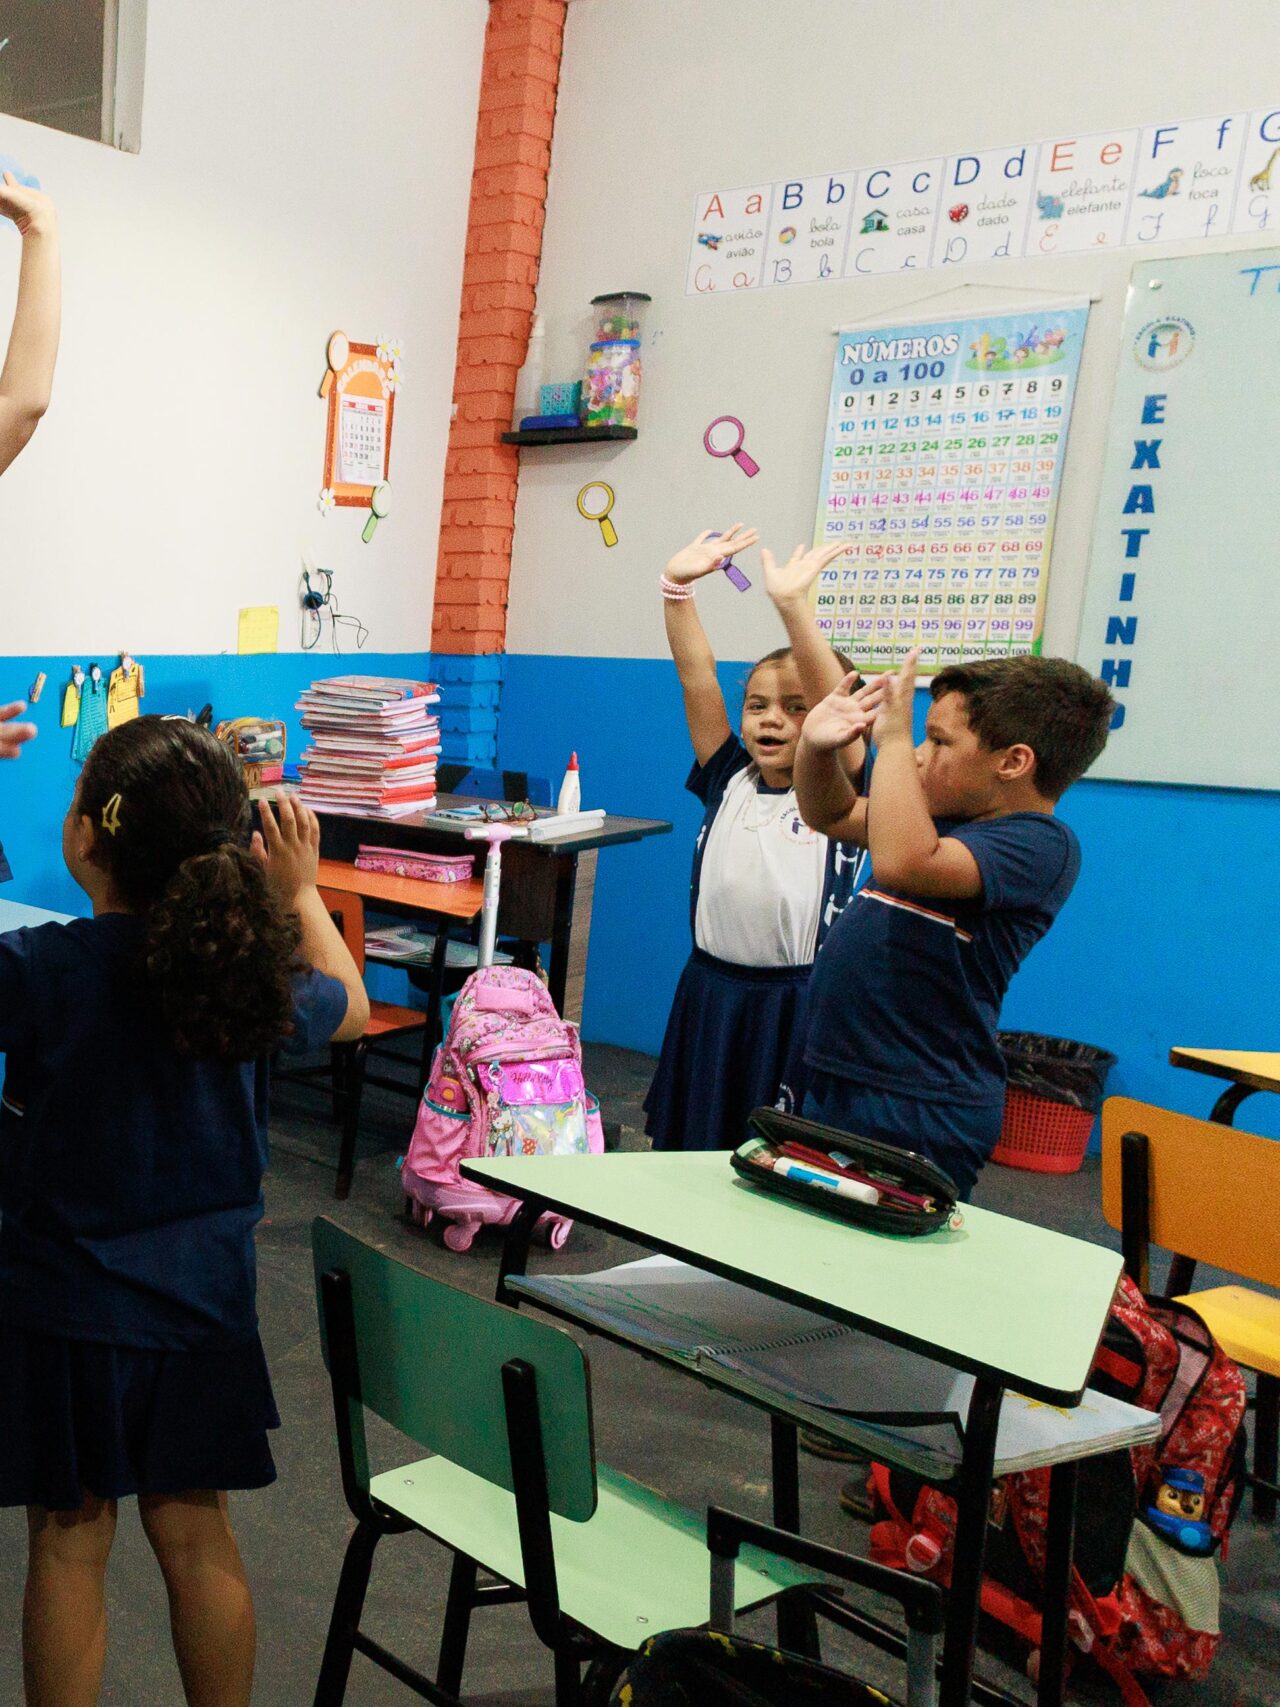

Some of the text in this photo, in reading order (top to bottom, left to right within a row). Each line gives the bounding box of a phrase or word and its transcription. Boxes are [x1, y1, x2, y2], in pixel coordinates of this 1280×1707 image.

[1152, 118, 1232, 159] F f
[953, 148, 1026, 186] D d
[1050, 141, 1122, 172] E e
[866, 170, 931, 199] C c
[1191, 161, 1233, 186] foca
[782, 177, 845, 210] B b
[1060, 176, 1128, 200] elefante
[1188, 187, 1219, 201] foca
[703, 194, 762, 221] A a
[896, 206, 931, 219] casa
[976, 192, 1017, 211] dado
[1066, 200, 1121, 216] elefante
[808, 216, 841, 233] bola
[897, 225, 926, 236] casa
[976, 214, 1009, 227] dado
[726, 245, 755, 259] avião
[810, 236, 835, 248] bola
[991, 230, 1011, 257] d
[772, 253, 833, 283] B b
[733, 271, 754, 288] a
[1240, 264, 1280, 296] T
[841, 333, 960, 366] NÚMEROS
[850, 360, 946, 385] 0 a 100
[844, 396, 854, 407] 0
[867, 394, 875, 406] 1
[888, 392, 899, 404] 2
[910, 390, 920, 402] 3
[931, 388, 942, 400] 4
[955, 387, 966, 399] 5
[979, 385, 990, 397] 6
[1002, 383, 1013, 395] 7
[1027, 381, 1037, 393] 8
[1051, 379, 1062, 391] 9
[839, 421, 855, 432] 10
[861, 419, 876, 430] 11
[883, 418, 899, 430] 12
[904, 416, 920, 427] 13
[925, 414, 942, 426] 14
[949, 412, 966, 424] 15
[972, 410, 990, 423] 16
[1020, 407, 1038, 419] 18
[1045, 406, 1062, 418] 19
[835, 446, 852, 457] 20
[857, 445, 873, 455] 21
[878, 443, 895, 454] 22
[900, 441, 917, 453] 23
[920, 440, 939, 451] 24
[944, 439, 963, 450] 25
[967, 437, 986, 449] 26
[992, 436, 1011, 447] 27
[1016, 434, 1035, 446] 28
[1040, 433, 1059, 444] 29
[832, 471, 849, 481] 30
[854, 470, 870, 481] 31
[876, 469, 892, 480] 32
[896, 468, 913, 478] 33
[918, 466, 935, 477] 34
[941, 465, 959, 476] 35
[964, 463, 983, 475] 36
[988, 462, 1007, 474] 37
[1012, 461, 1031, 473] 38
[1036, 460, 1054, 471] 39
[826, 513, 1047, 532] 50 51 53 54 55 56 57 58 59
[886, 544, 903, 555] 63
[907, 543, 925, 554] 64
[930, 543, 948, 553] 65
[953, 542, 972, 553] 66
[977, 542, 996, 553] 67
[1001, 541, 1020, 552] 68
[1025, 541, 1043, 552] 69
[821, 567, 1040, 580] 70 71 72 73 74 75 76 77 78 79
[817, 593, 1036, 605] 80 81 82 83 84 85 86 87 88 89
[836, 619, 851, 630] 91
[856, 619, 873, 630] 92
[877, 619, 894, 630] 93
[898, 619, 916, 630] 94
[921, 620, 939, 630] 95
[943, 620, 962, 630] 96
[966, 620, 986, 631] 97
[991, 620, 1010, 631] 98
[1015, 620, 1033, 631] 99
